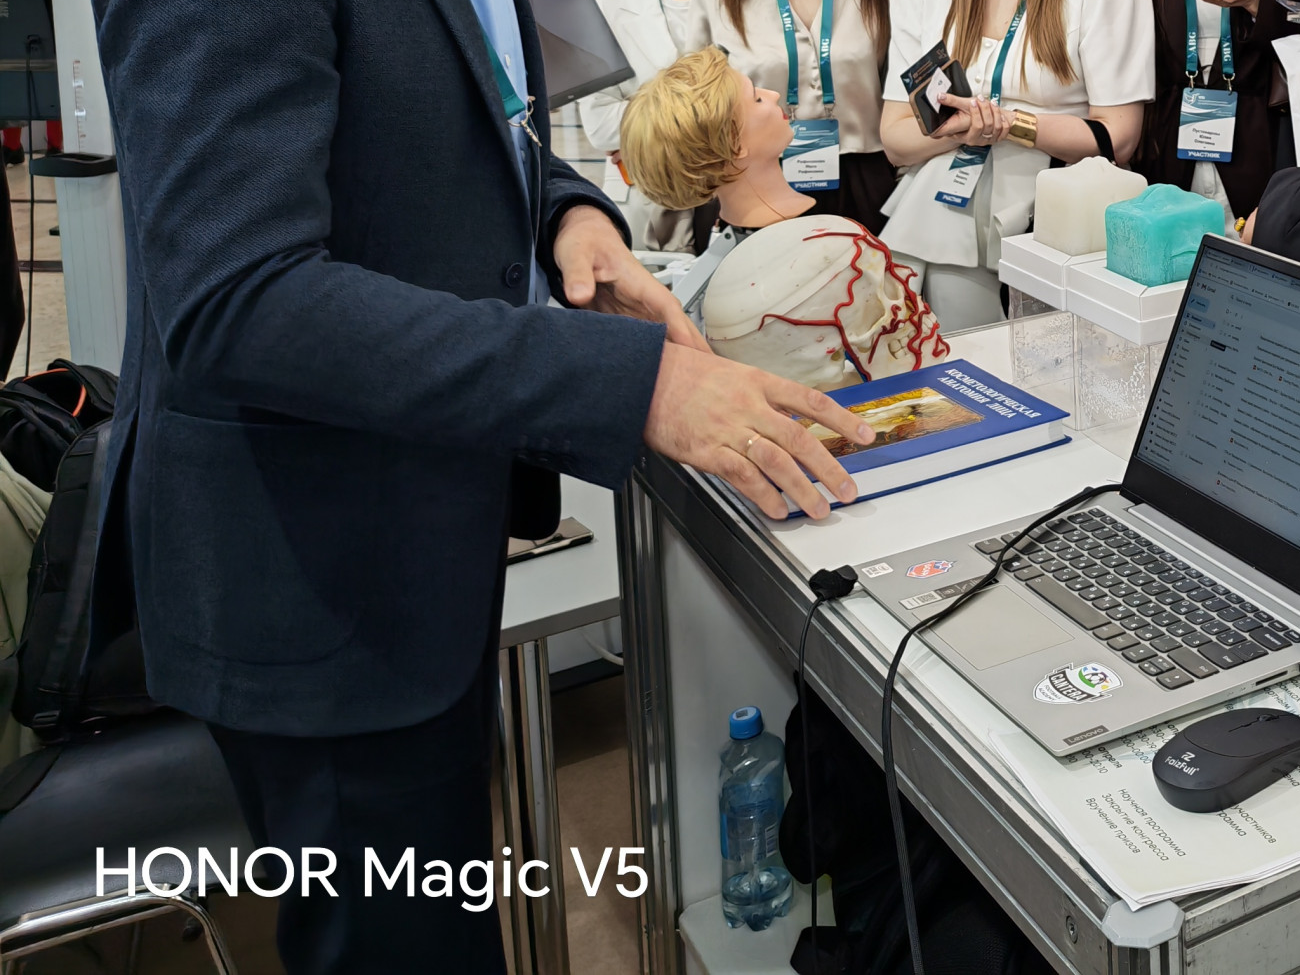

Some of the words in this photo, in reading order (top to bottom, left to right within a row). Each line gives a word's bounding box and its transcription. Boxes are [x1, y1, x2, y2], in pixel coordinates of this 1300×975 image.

[1188, 31, 1197, 52] ABG
[937, 375, 989, 406] АНАТОМИЯ
[985, 402, 1018, 420] ЛИЦА
[944, 368, 1042, 419] КОСМЕТОЛОГИЧЕСКАЯ
[1051, 673, 1088, 701] CANTERA
[1067, 727, 1105, 745] Lenovo
[1097, 746, 1123, 769] апреля
[1086, 797, 1117, 830] Вручение
[1114, 828, 1141, 855] призов
[1102, 792, 1135, 825] Закрытие
[1131, 822, 1169, 862] конгресса
[1145, 815, 1186, 857] программа
[1233, 804, 1277, 844] участников
